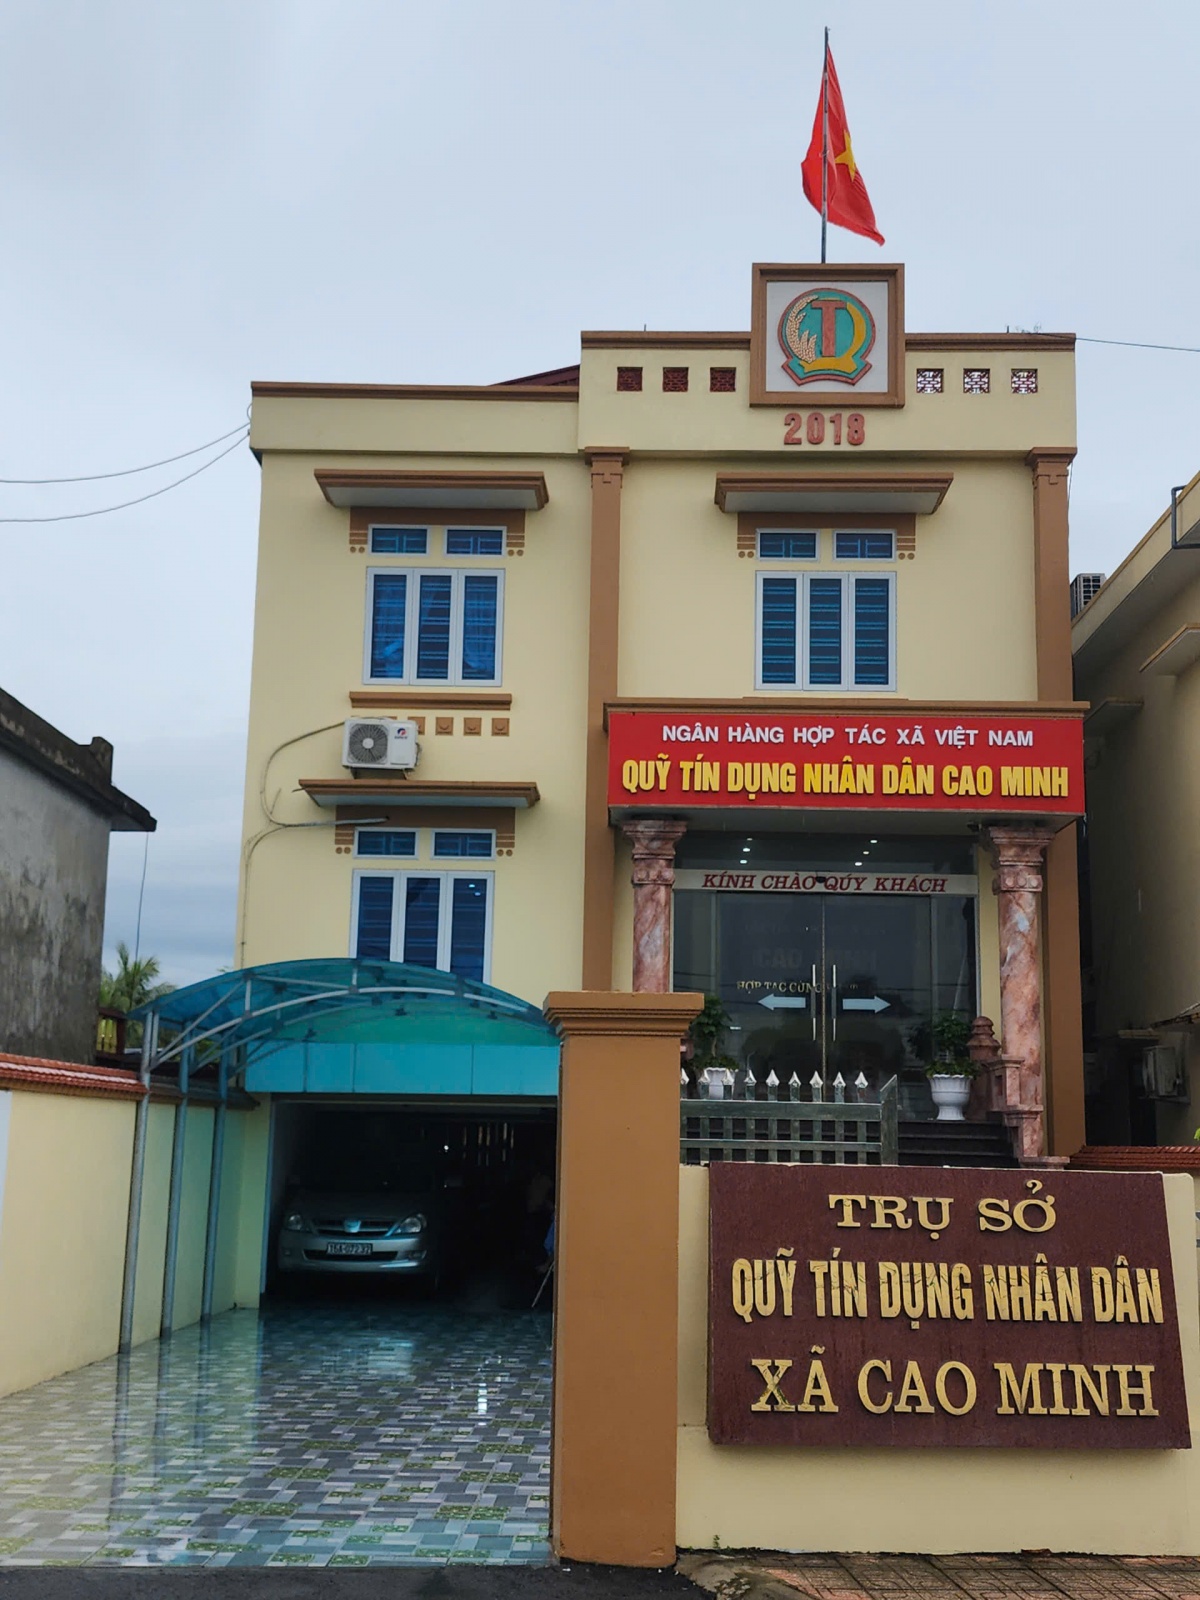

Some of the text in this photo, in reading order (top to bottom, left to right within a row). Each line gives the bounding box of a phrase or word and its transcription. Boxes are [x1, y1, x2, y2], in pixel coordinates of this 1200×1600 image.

[784, 412, 866, 446] 2018
[663, 722, 1034, 749] NGÂN HÀNG HỢP TÁC XÃ VIỆT NAM
[622, 754, 1069, 800] QUỸ TÍN DỤNG NHÂN DÂN CAO MINH
[702, 871, 756, 889] KÍNH
[761, 873, 817, 890] CHÀO
[873, 875, 948, 893] KHÁCH
[828, 1179, 1057, 1240] TRỤ SỞ
[731, 1247, 1165, 1330] QUỸ TÍN DỤNG NHÂN DÂN
[751, 1345, 1160, 1417] XÃ CAO MINH
